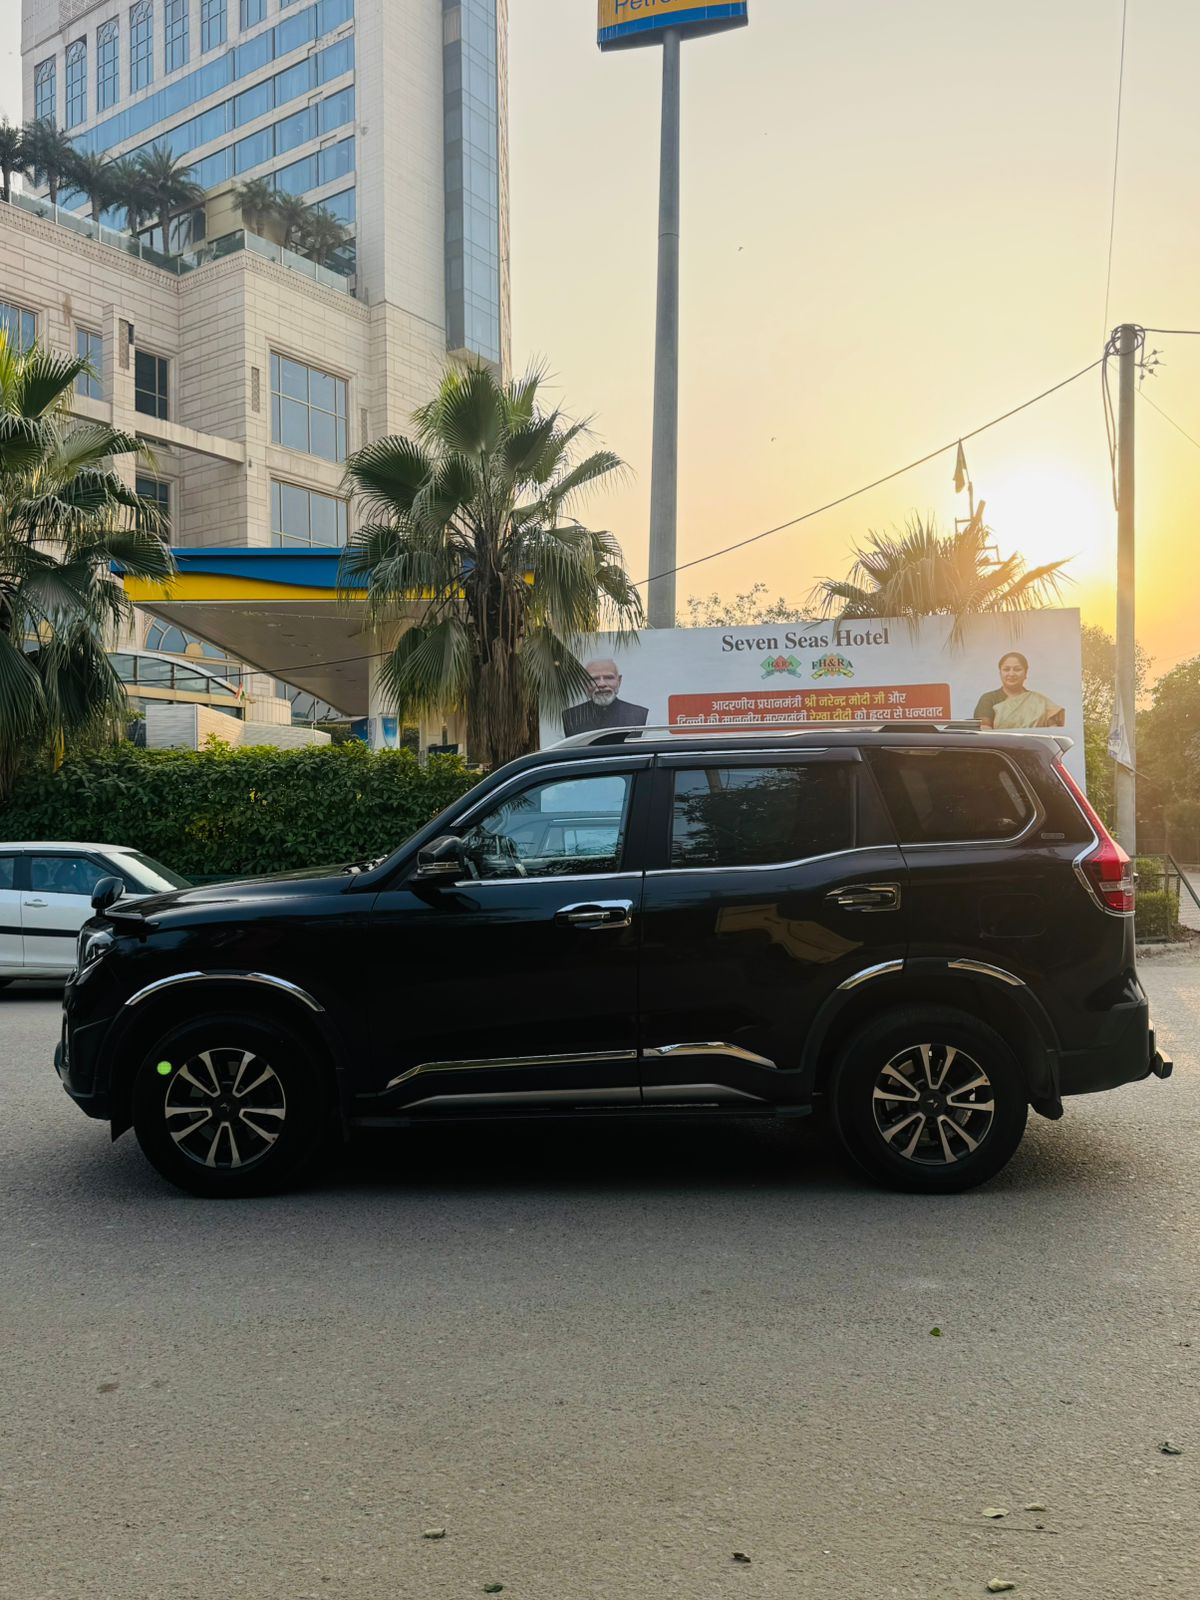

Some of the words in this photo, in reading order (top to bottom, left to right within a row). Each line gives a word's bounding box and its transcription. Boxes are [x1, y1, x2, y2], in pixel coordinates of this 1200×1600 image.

[721, 634, 779, 652] Seven
[784, 631, 829, 649] Seas
[835, 628, 889, 647] Hotel
[712, 697, 755, 710] आदरणीय
[758, 695, 802, 708] प्रधानमंत्री
[804, 693, 817, 707] श्री
[819, 694, 846, 707] नरेन्द्र
[848, 692, 871, 705] मोदी
[873, 691, 885, 704] जी
[888, 691, 906, 703] और
[854, 707, 868, 720] को
[893, 706, 903, 719] से
[905, 707, 943, 718] धन्यवाद
